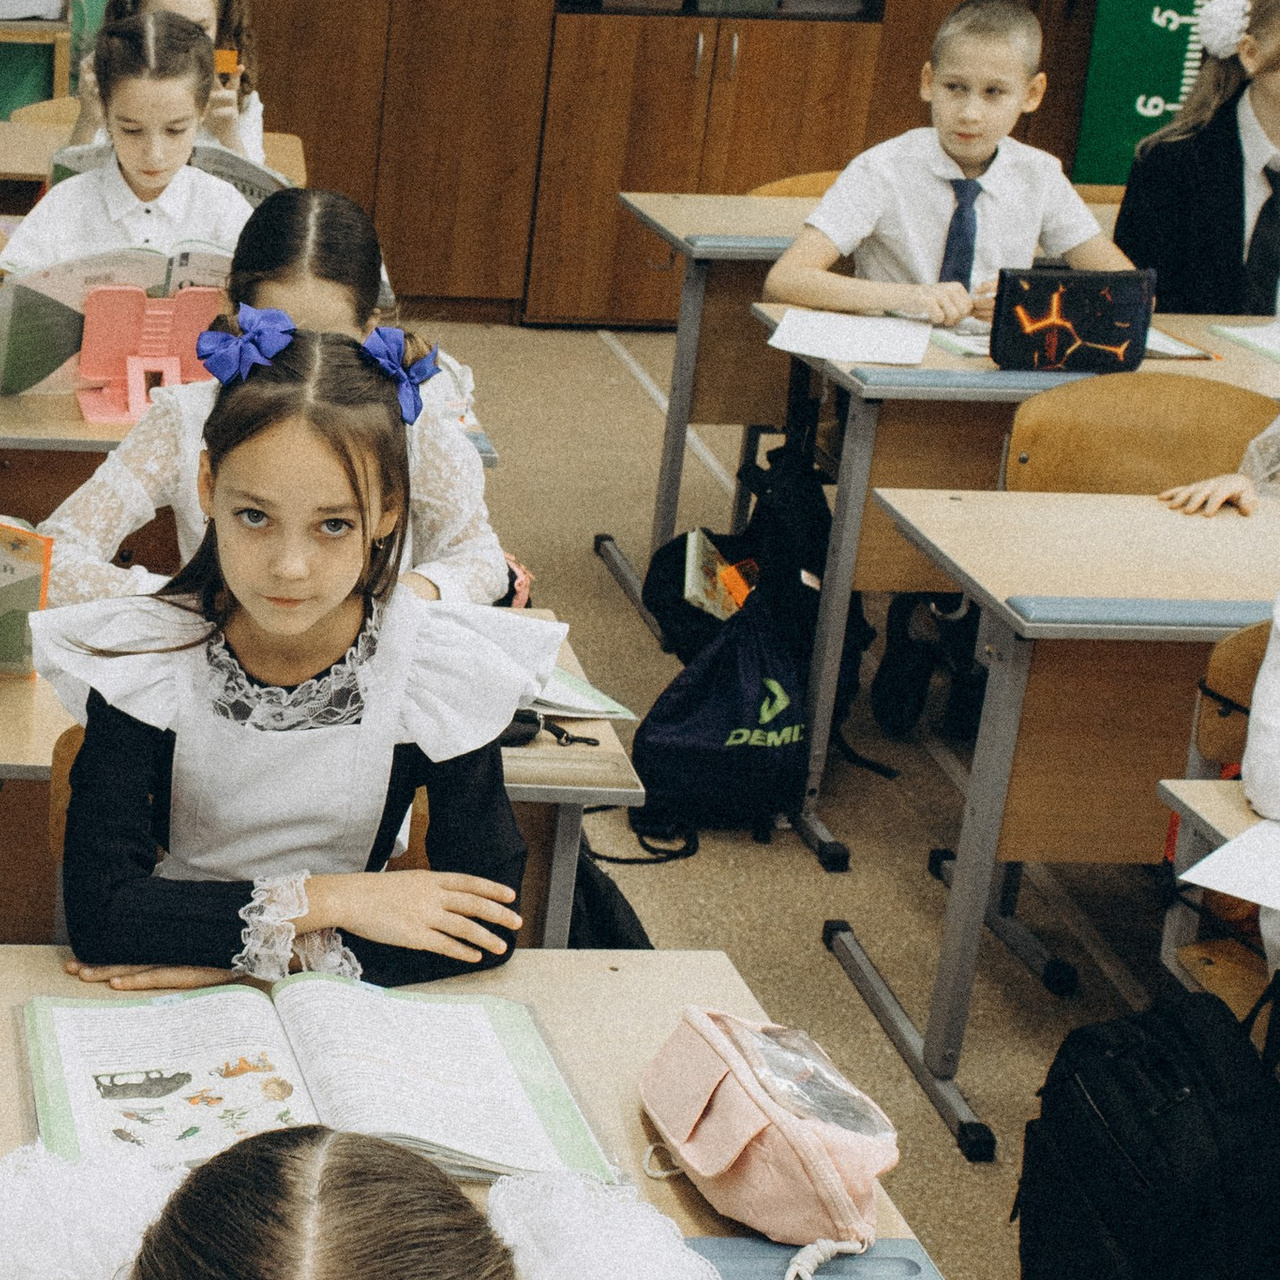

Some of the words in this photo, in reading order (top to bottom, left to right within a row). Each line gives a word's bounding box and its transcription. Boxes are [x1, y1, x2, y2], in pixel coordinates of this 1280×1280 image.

[1153, 7, 1181, 30] 5
[1136, 94, 1166, 116] 6
[725, 724, 805, 747] DEMI
